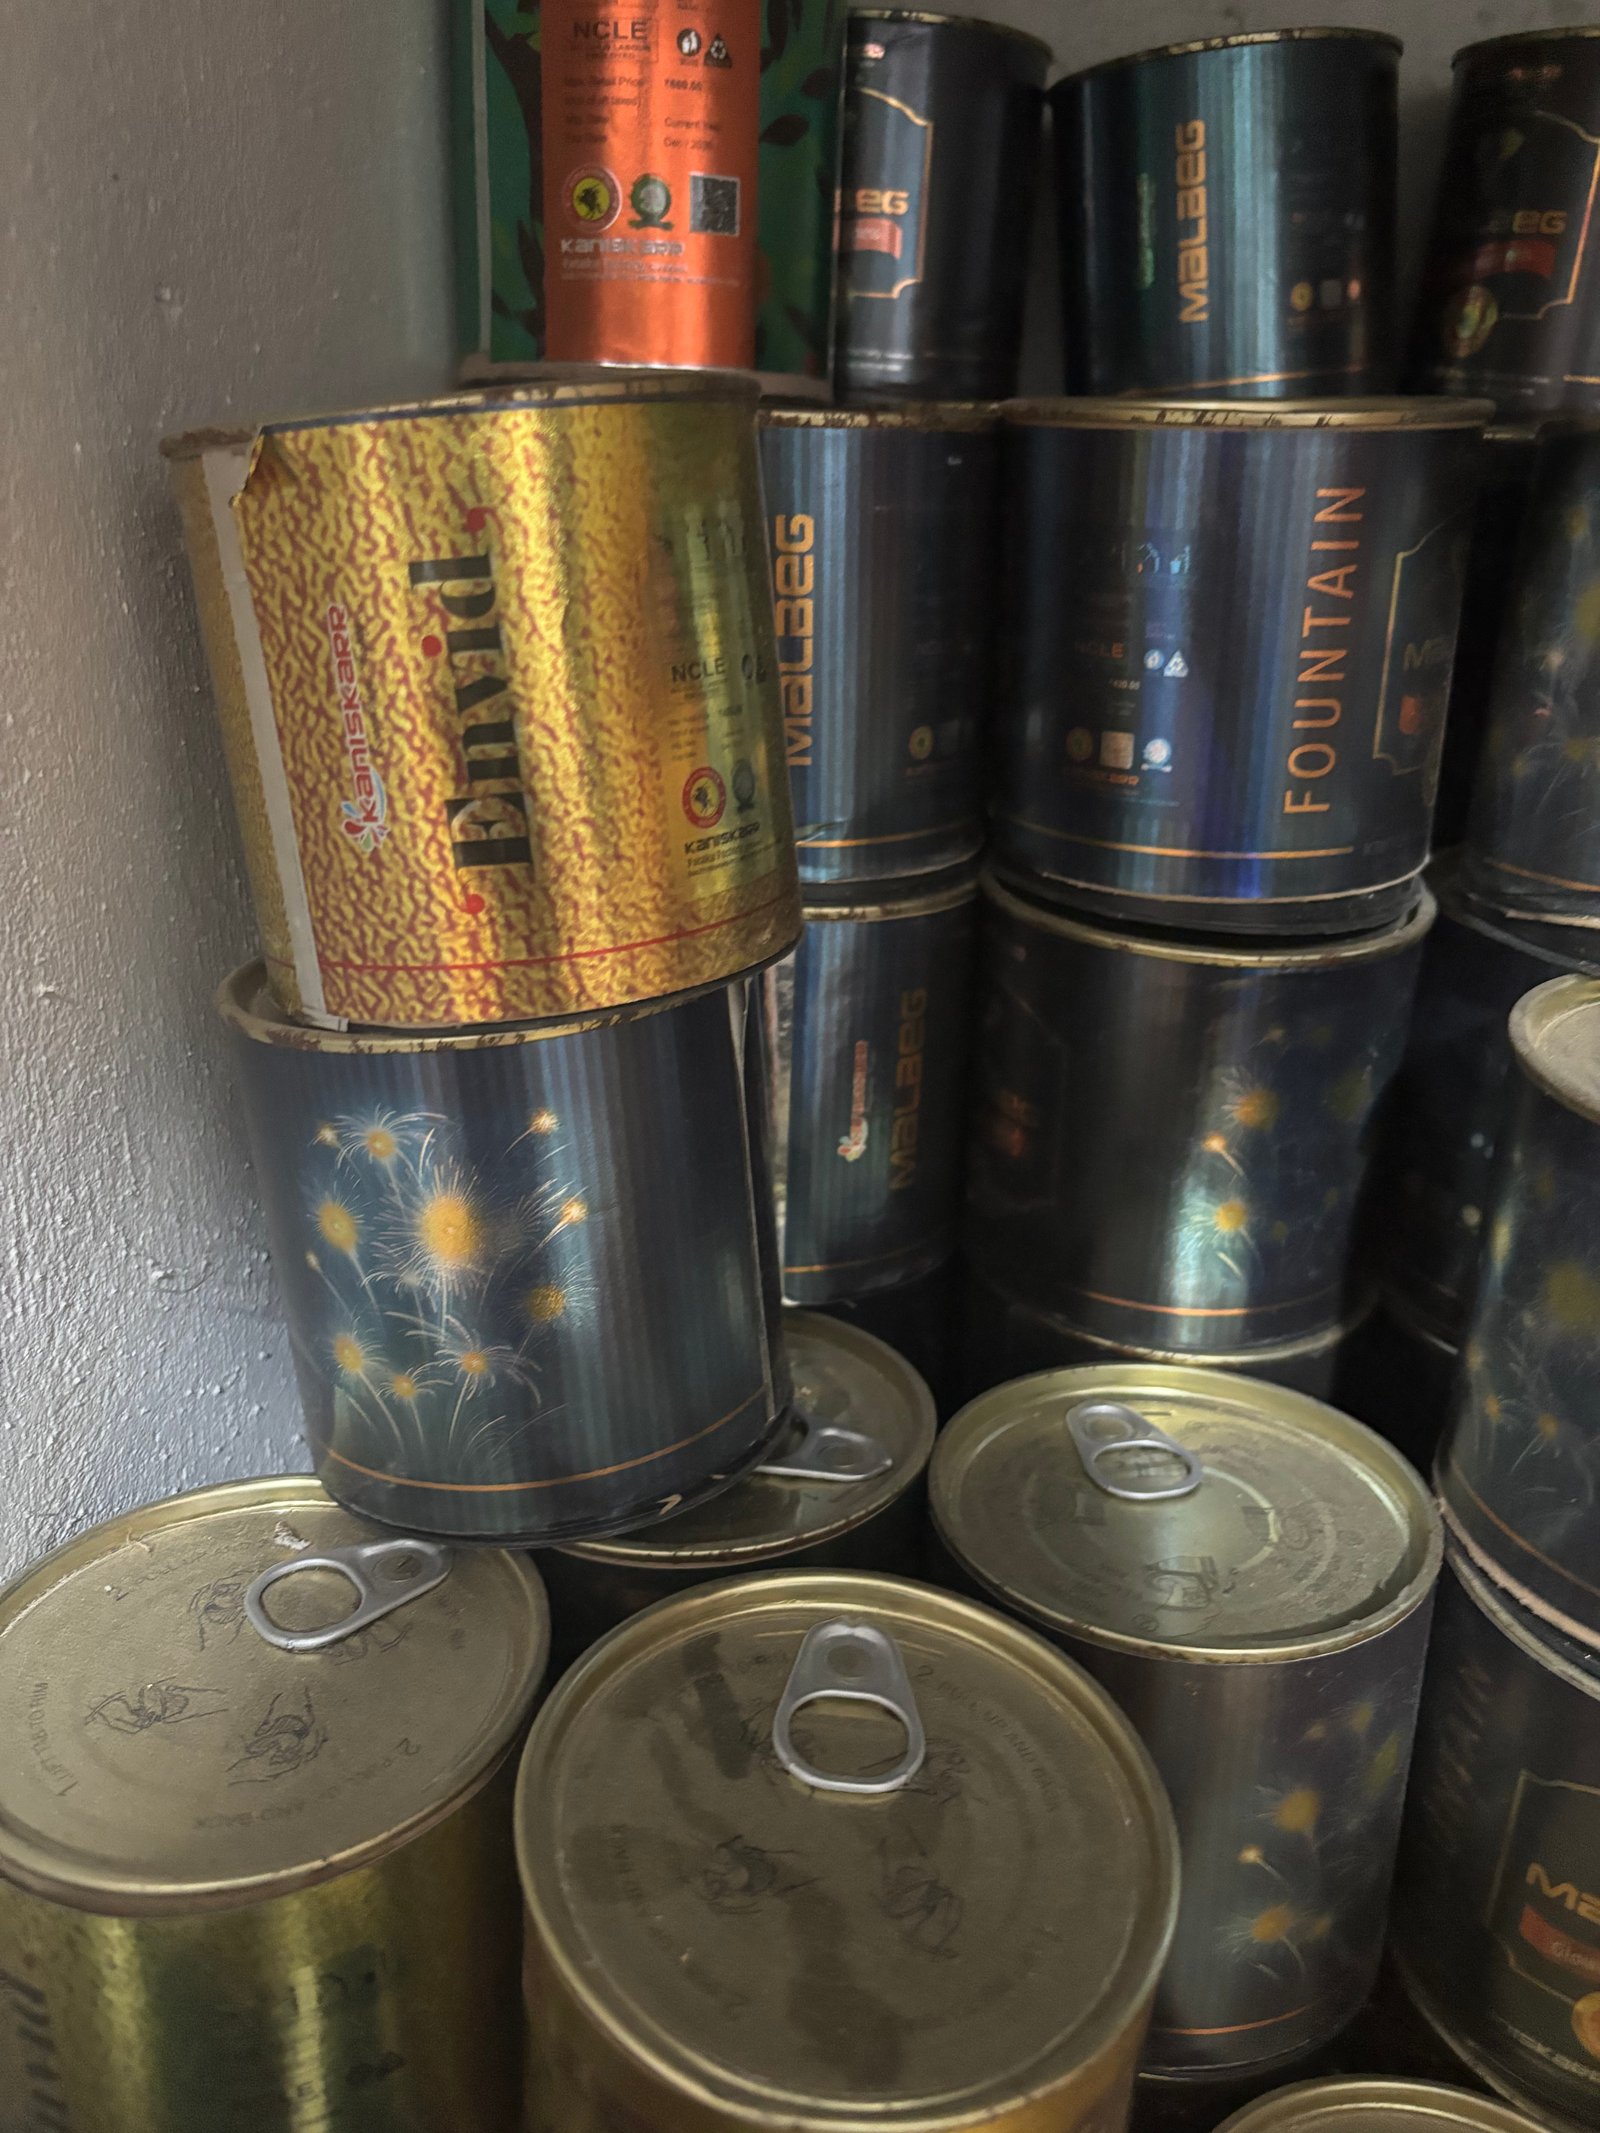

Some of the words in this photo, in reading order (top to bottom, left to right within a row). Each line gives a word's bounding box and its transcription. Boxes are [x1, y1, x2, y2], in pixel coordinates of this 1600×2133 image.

[573, 20, 650, 41] NCLE
[408, 550, 534, 868] Envid
[671, 656, 728, 684] NCLE
[1283, 487, 1366, 814] FOUNTAIN
